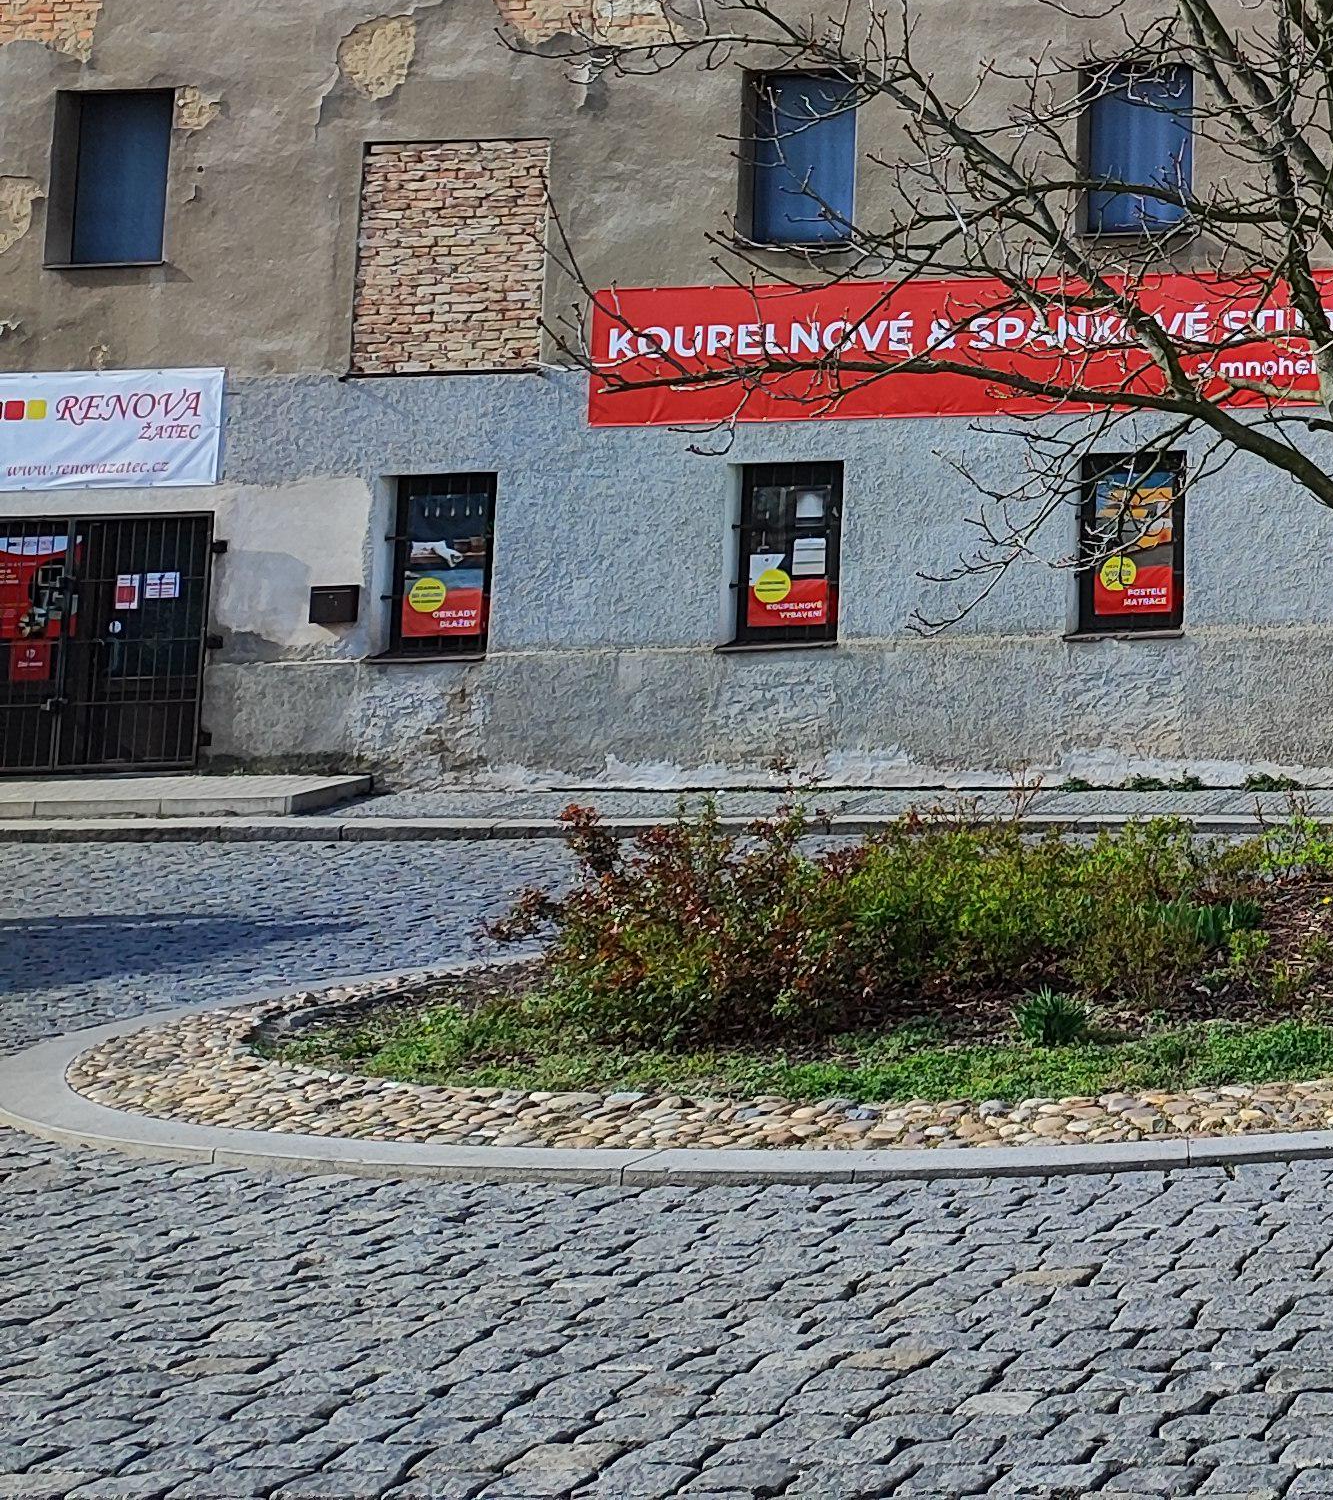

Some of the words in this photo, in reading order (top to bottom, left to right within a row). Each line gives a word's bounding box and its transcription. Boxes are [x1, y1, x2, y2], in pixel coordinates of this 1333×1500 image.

[608, 311, 914, 359] KOUPELNOVÉ
[926, 318, 956, 351] &
[968, 304, 1209, 349] SPÁNKVÉ
[56, 388, 201, 426] RENOVA
[138, 421, 201, 441] ŽATEC
[7, 461, 169, 477] www.renovazatec.cz
